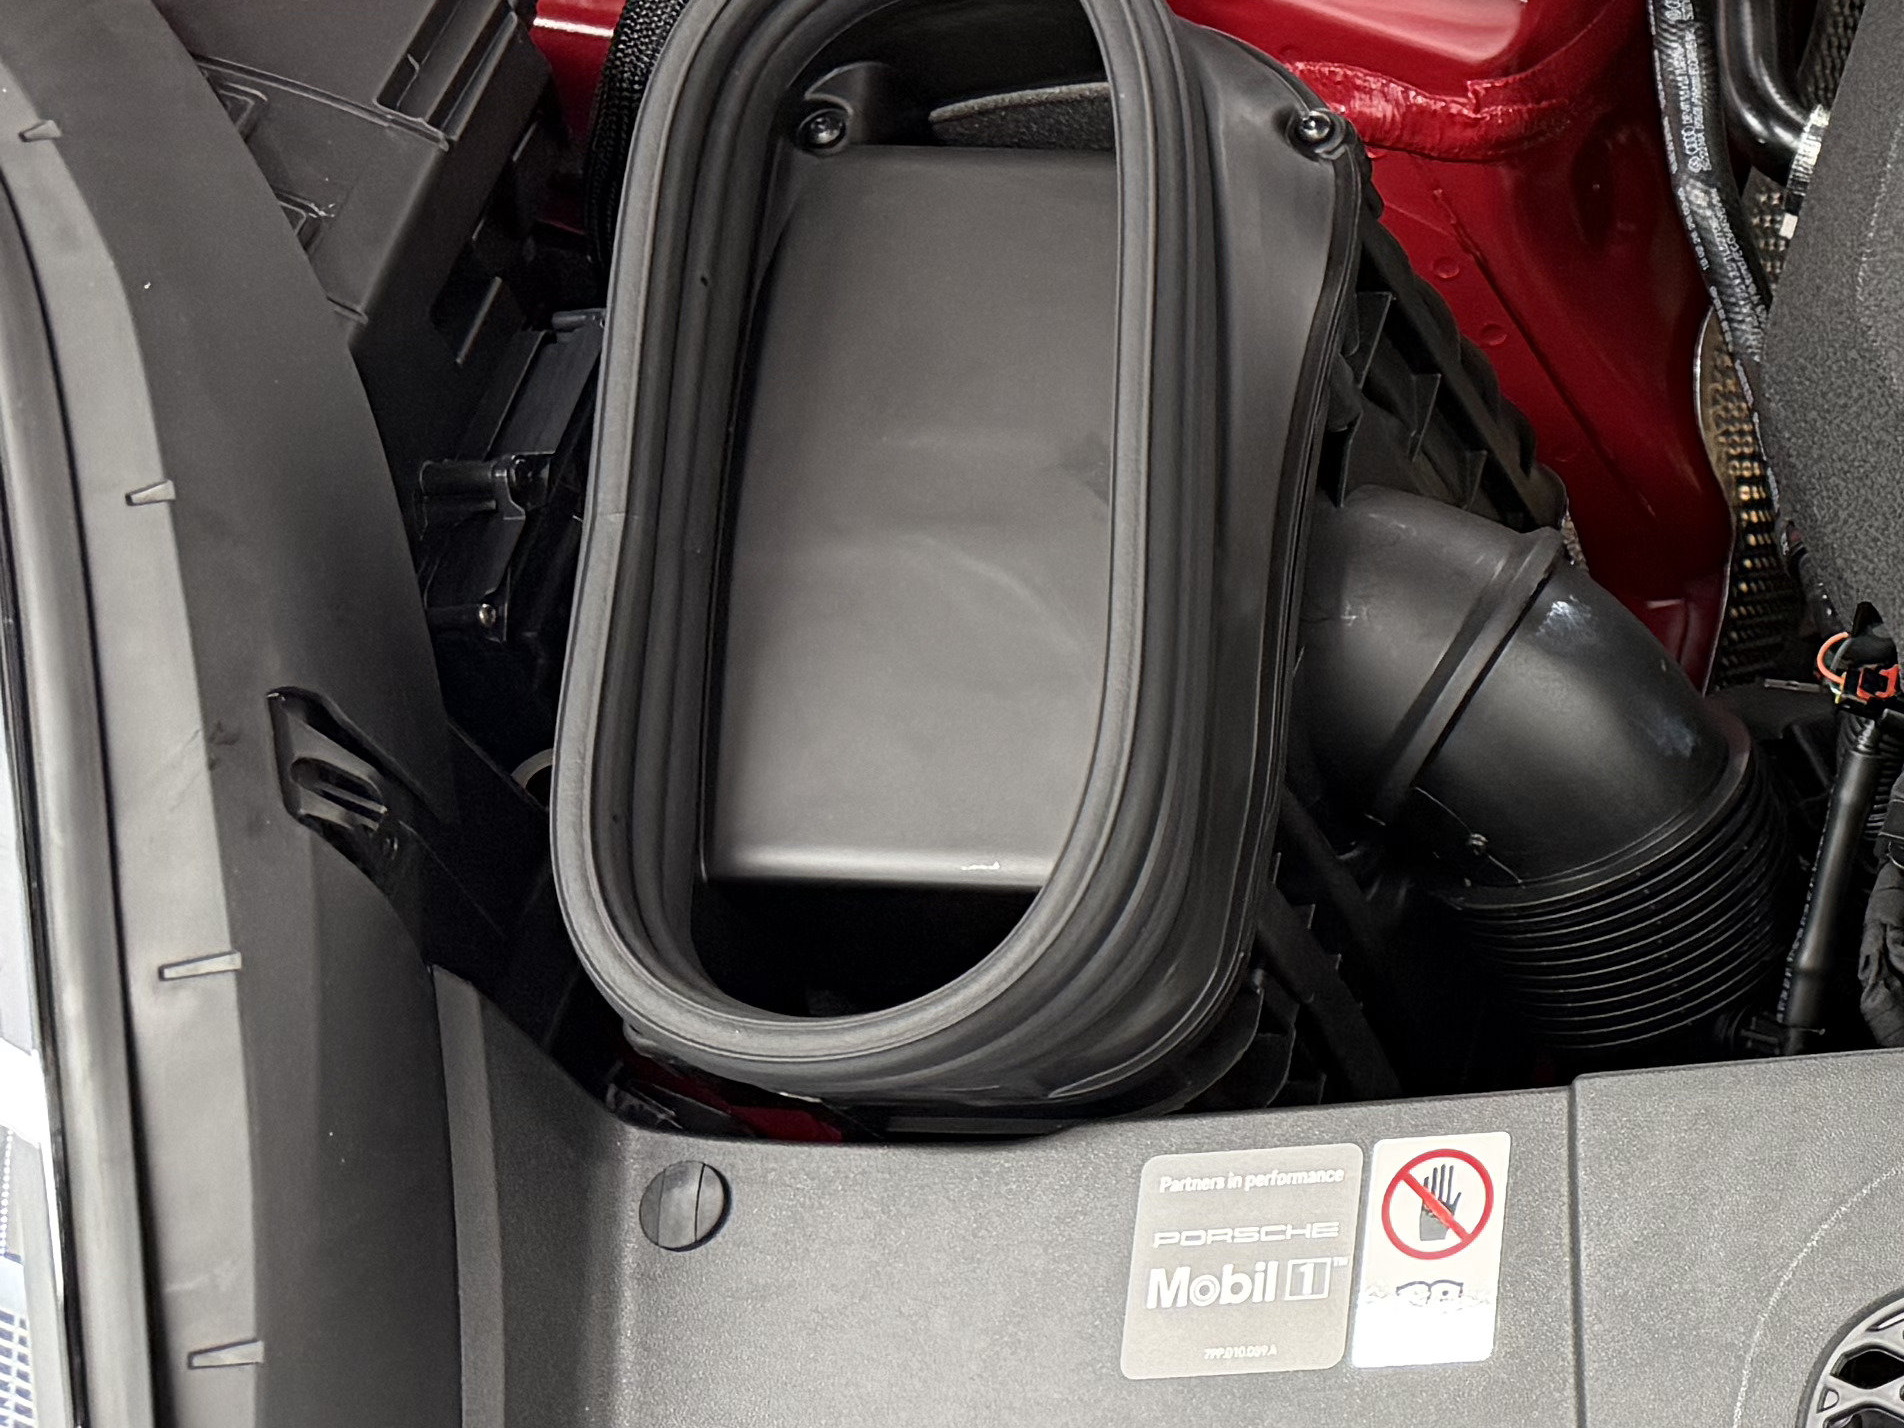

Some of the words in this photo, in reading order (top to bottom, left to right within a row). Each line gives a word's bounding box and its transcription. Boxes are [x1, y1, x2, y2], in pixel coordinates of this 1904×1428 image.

[1159, 1175, 1226, 1194] Partners
[1228, 1171, 1243, 1190] in
[1243, 1169, 1345, 1192] performance
[1152, 1220, 1341, 1249] PORSCHE
[1146, 1260, 1279, 1310] Mobil
